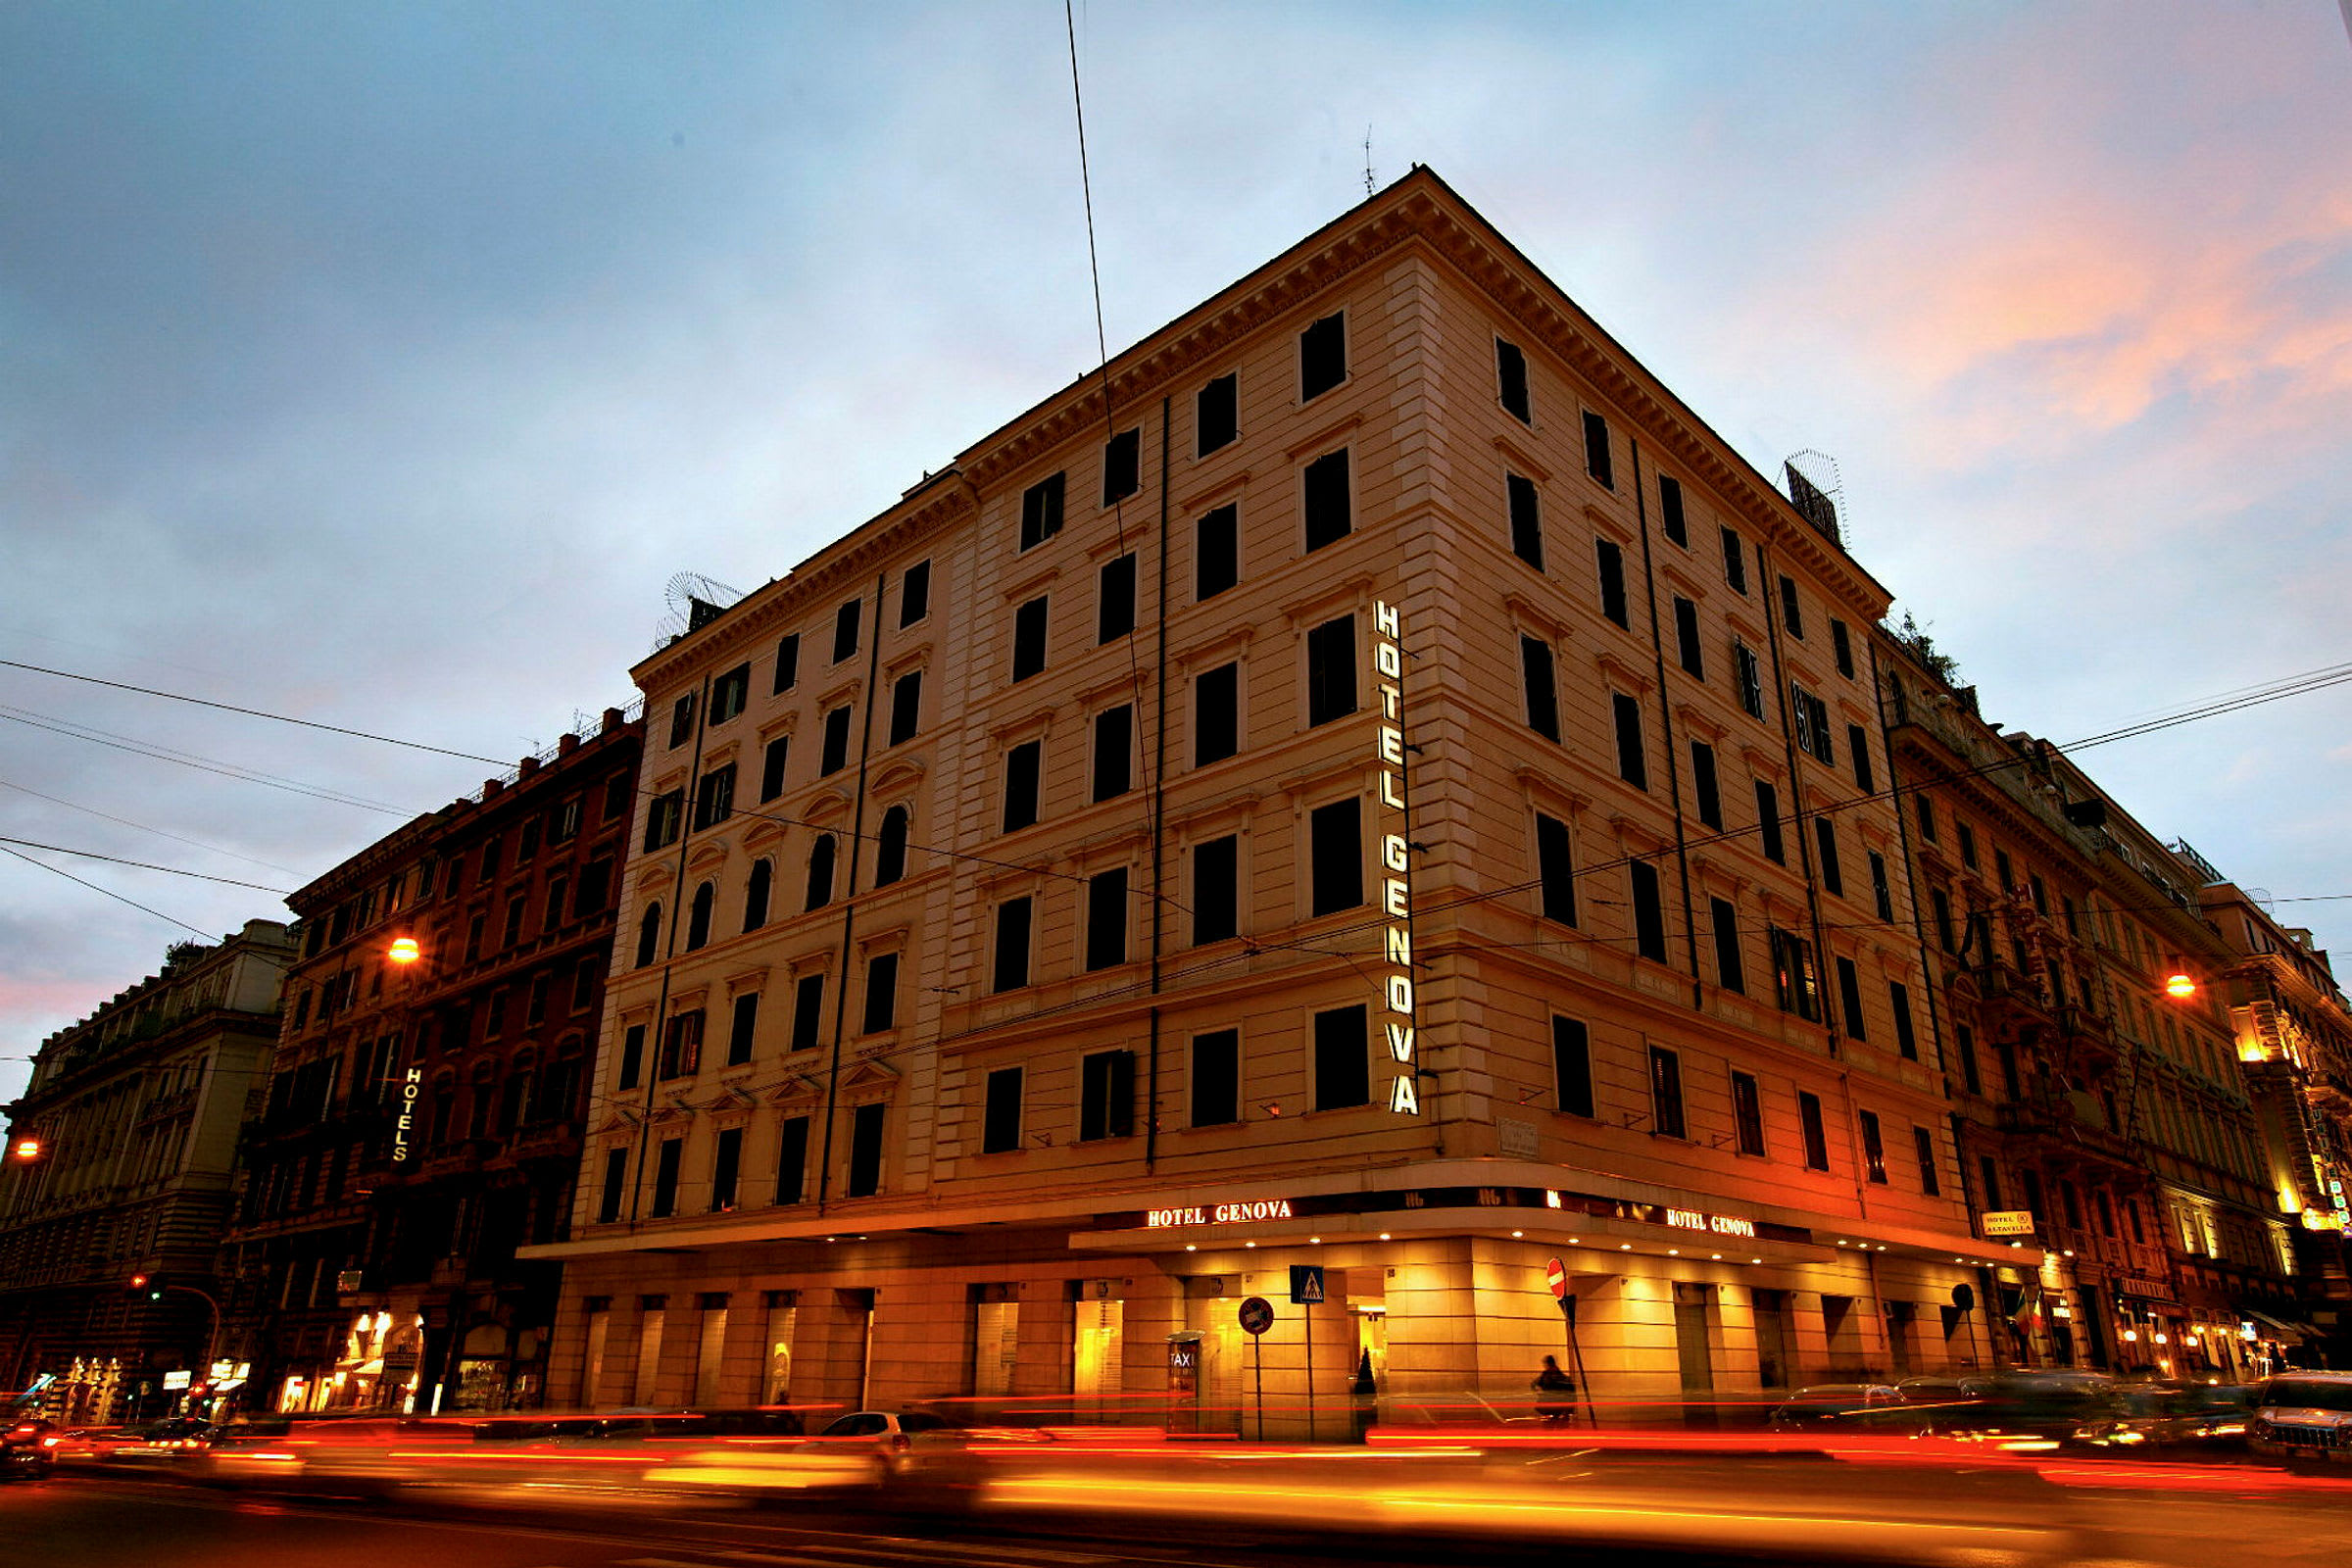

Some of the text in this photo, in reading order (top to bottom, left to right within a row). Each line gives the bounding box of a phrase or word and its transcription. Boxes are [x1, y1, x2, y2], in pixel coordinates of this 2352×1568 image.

[1375, 600, 1418, 1114] HOTEL GENOVA
[393, 1068, 420, 1161] HOTELS
[1148, 1200, 1292, 1226] HOTEL GENOVA
[1666, 1208, 1754, 1237] HOTEL GENOVA
[1170, 1352, 1195, 1367] TAXI
